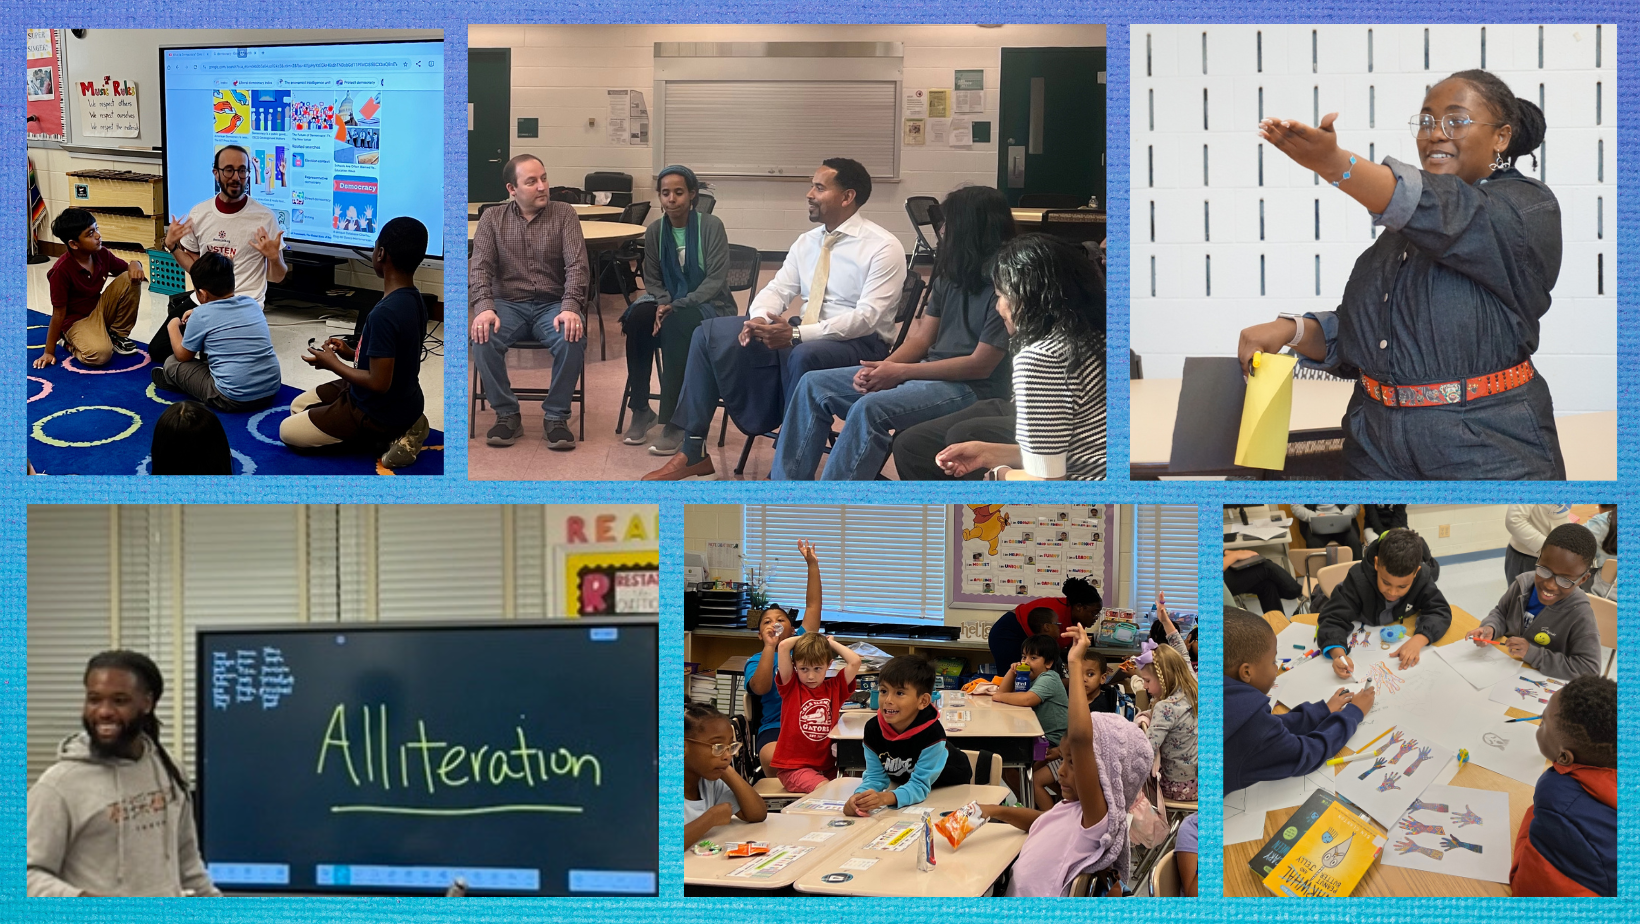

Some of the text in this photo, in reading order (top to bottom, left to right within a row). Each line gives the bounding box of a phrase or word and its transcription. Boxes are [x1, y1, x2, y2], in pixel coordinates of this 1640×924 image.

[80, 80, 136, 96] Music Rules
[88, 99, 132, 109] We respect others
[100, 110, 114, 120] respect
[117, 111, 135, 119] ourselves
[339, 182, 376, 192] Democracy
[566, 513, 659, 544] REA
[616, 573, 659, 587] RESTA
[583, 572, 610, 613] R
[803, 723, 830, 732] GATORS
[317, 703, 601, 793] Alliteration
[884, 757, 912, 772] NIKE
[1360, 830, 1370, 840] BEN
[1296, 856, 1317, 872] JELLY
[1315, 878, 1338, 894] PEANUT
[1320, 872, 1341, 888] BUTTER
